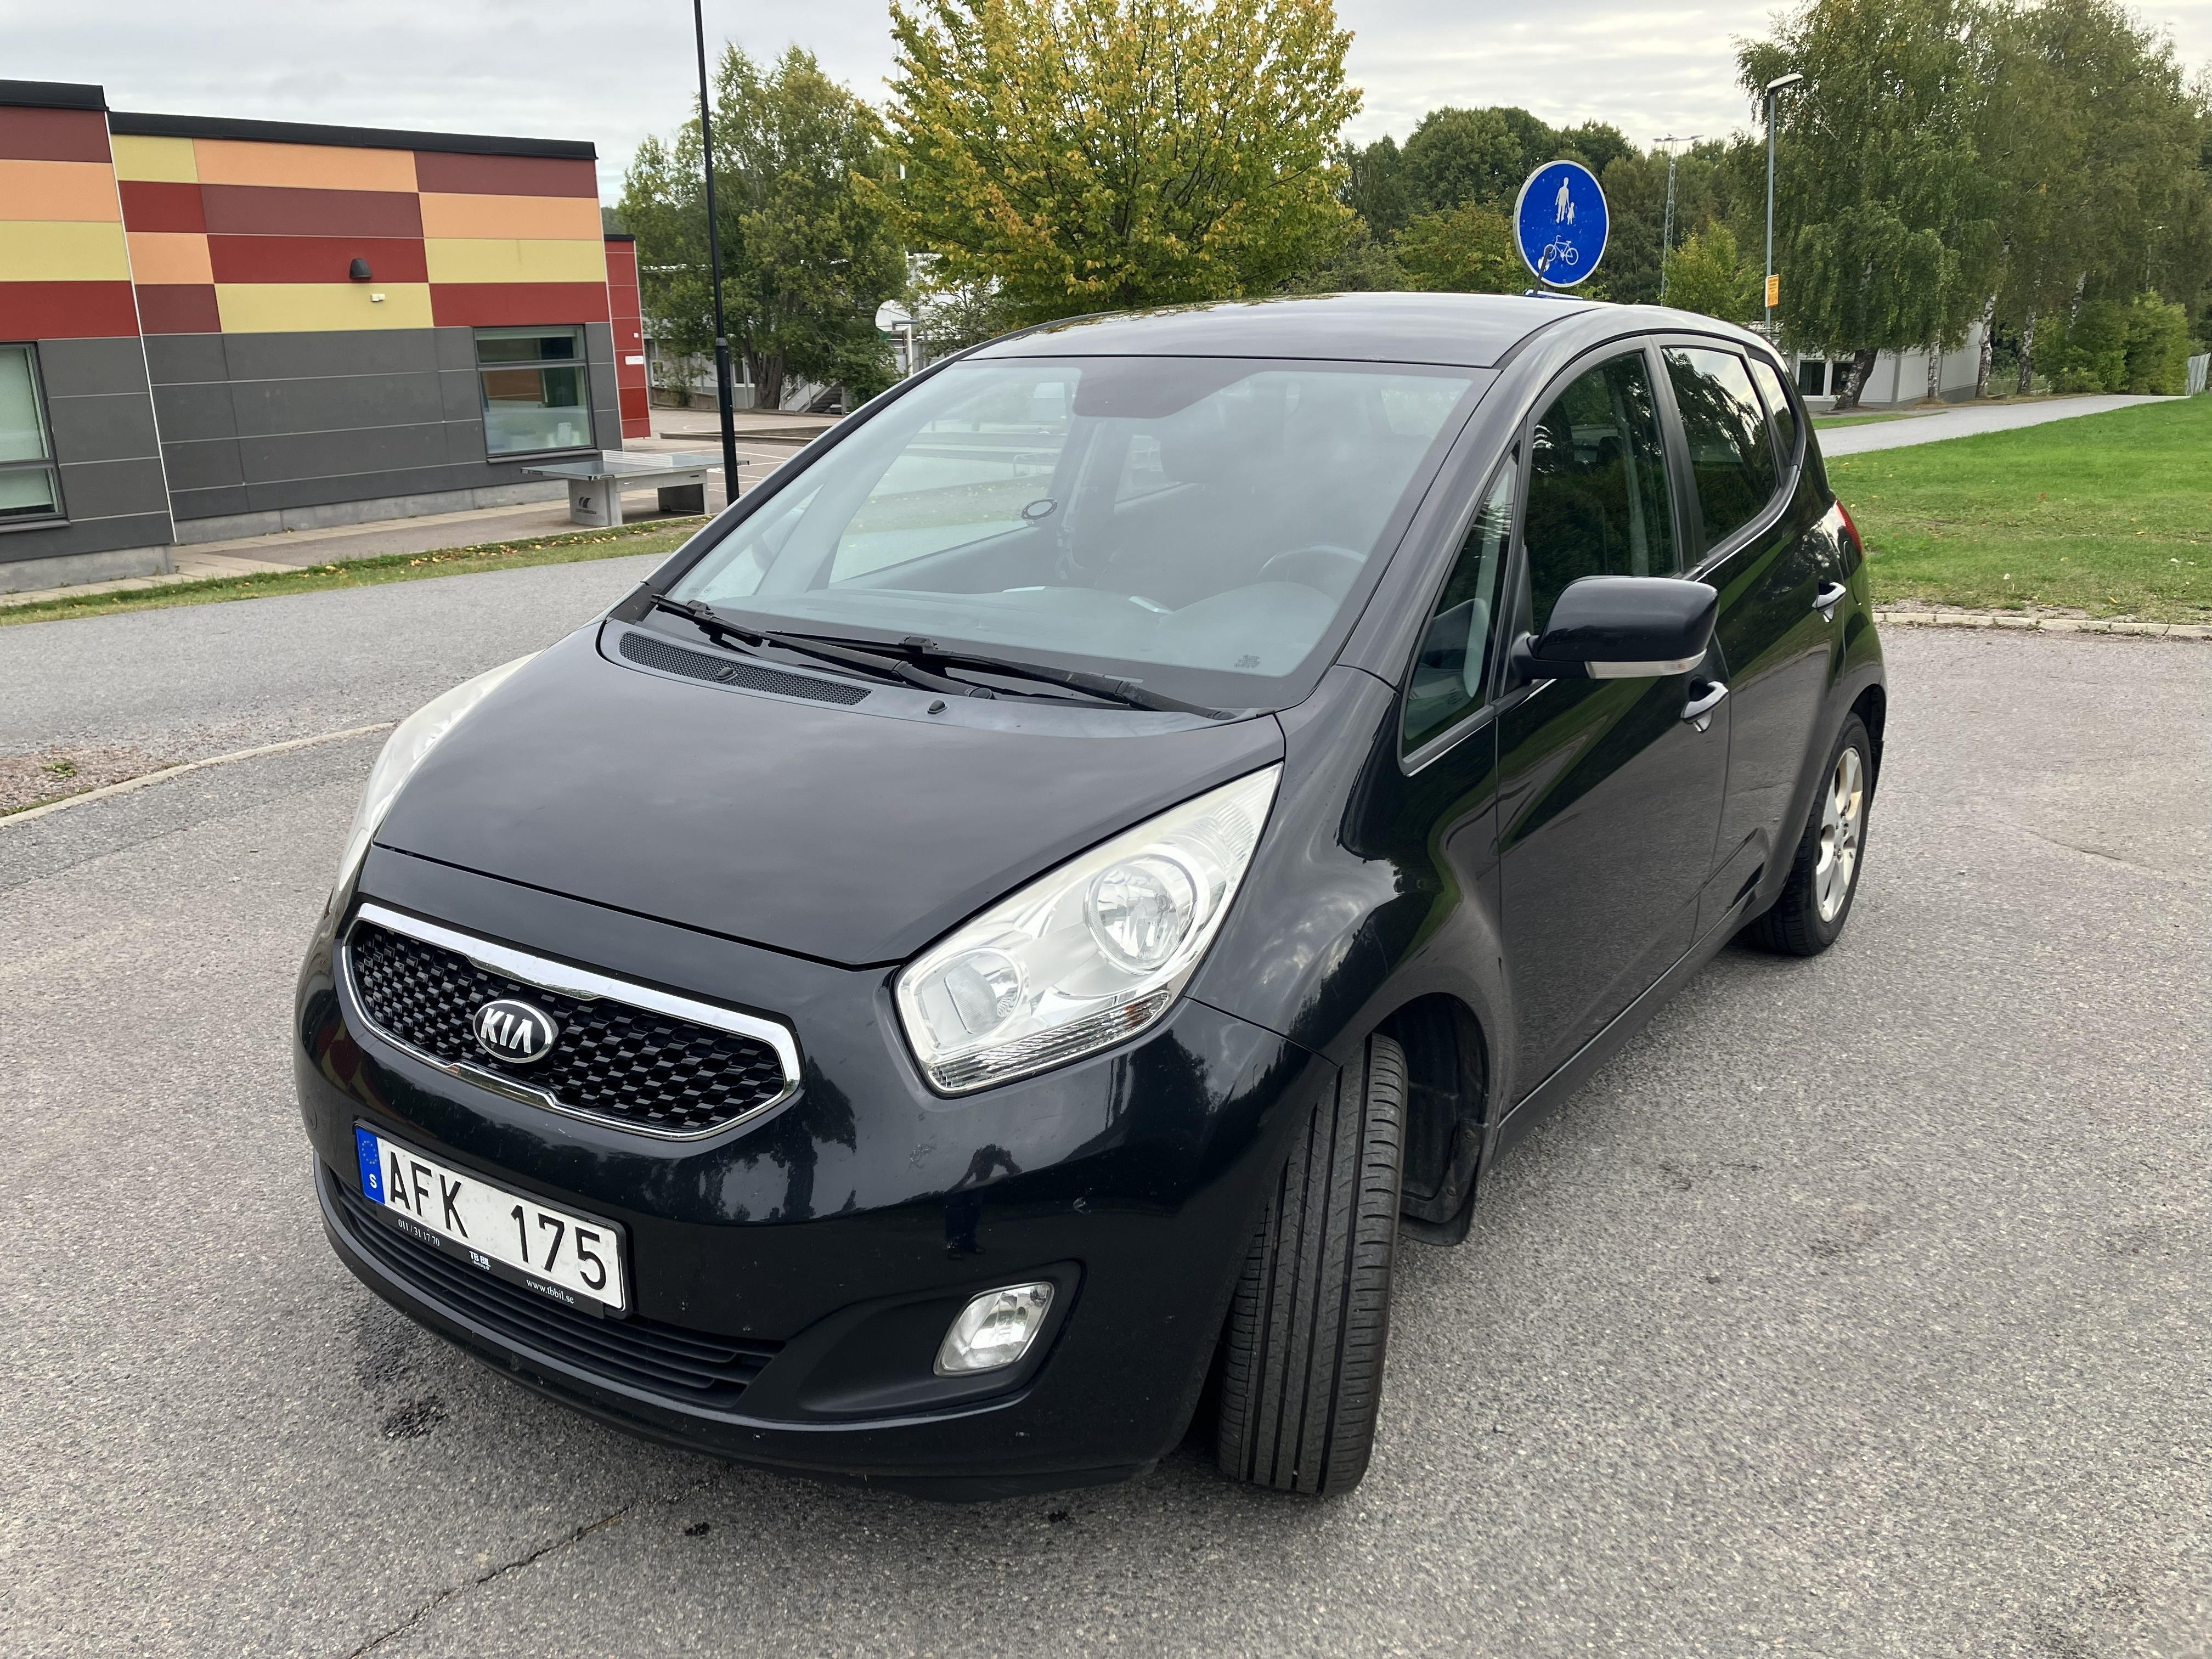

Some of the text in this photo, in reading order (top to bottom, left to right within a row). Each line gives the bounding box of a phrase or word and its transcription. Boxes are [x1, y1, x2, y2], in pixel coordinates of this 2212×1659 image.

[481, 1008, 533, 1054] KIA
[369, 1173, 377, 1189] S
[390, 1151, 606, 1290] AFK 175
[423, 1232, 430, 1242] 17
[431, 1235, 440, 1246] 70
[469, 1250, 479, 1262] TB
[479, 1255, 491, 1267] BIL
[526, 1279, 574, 1304] www.tbbil.se
